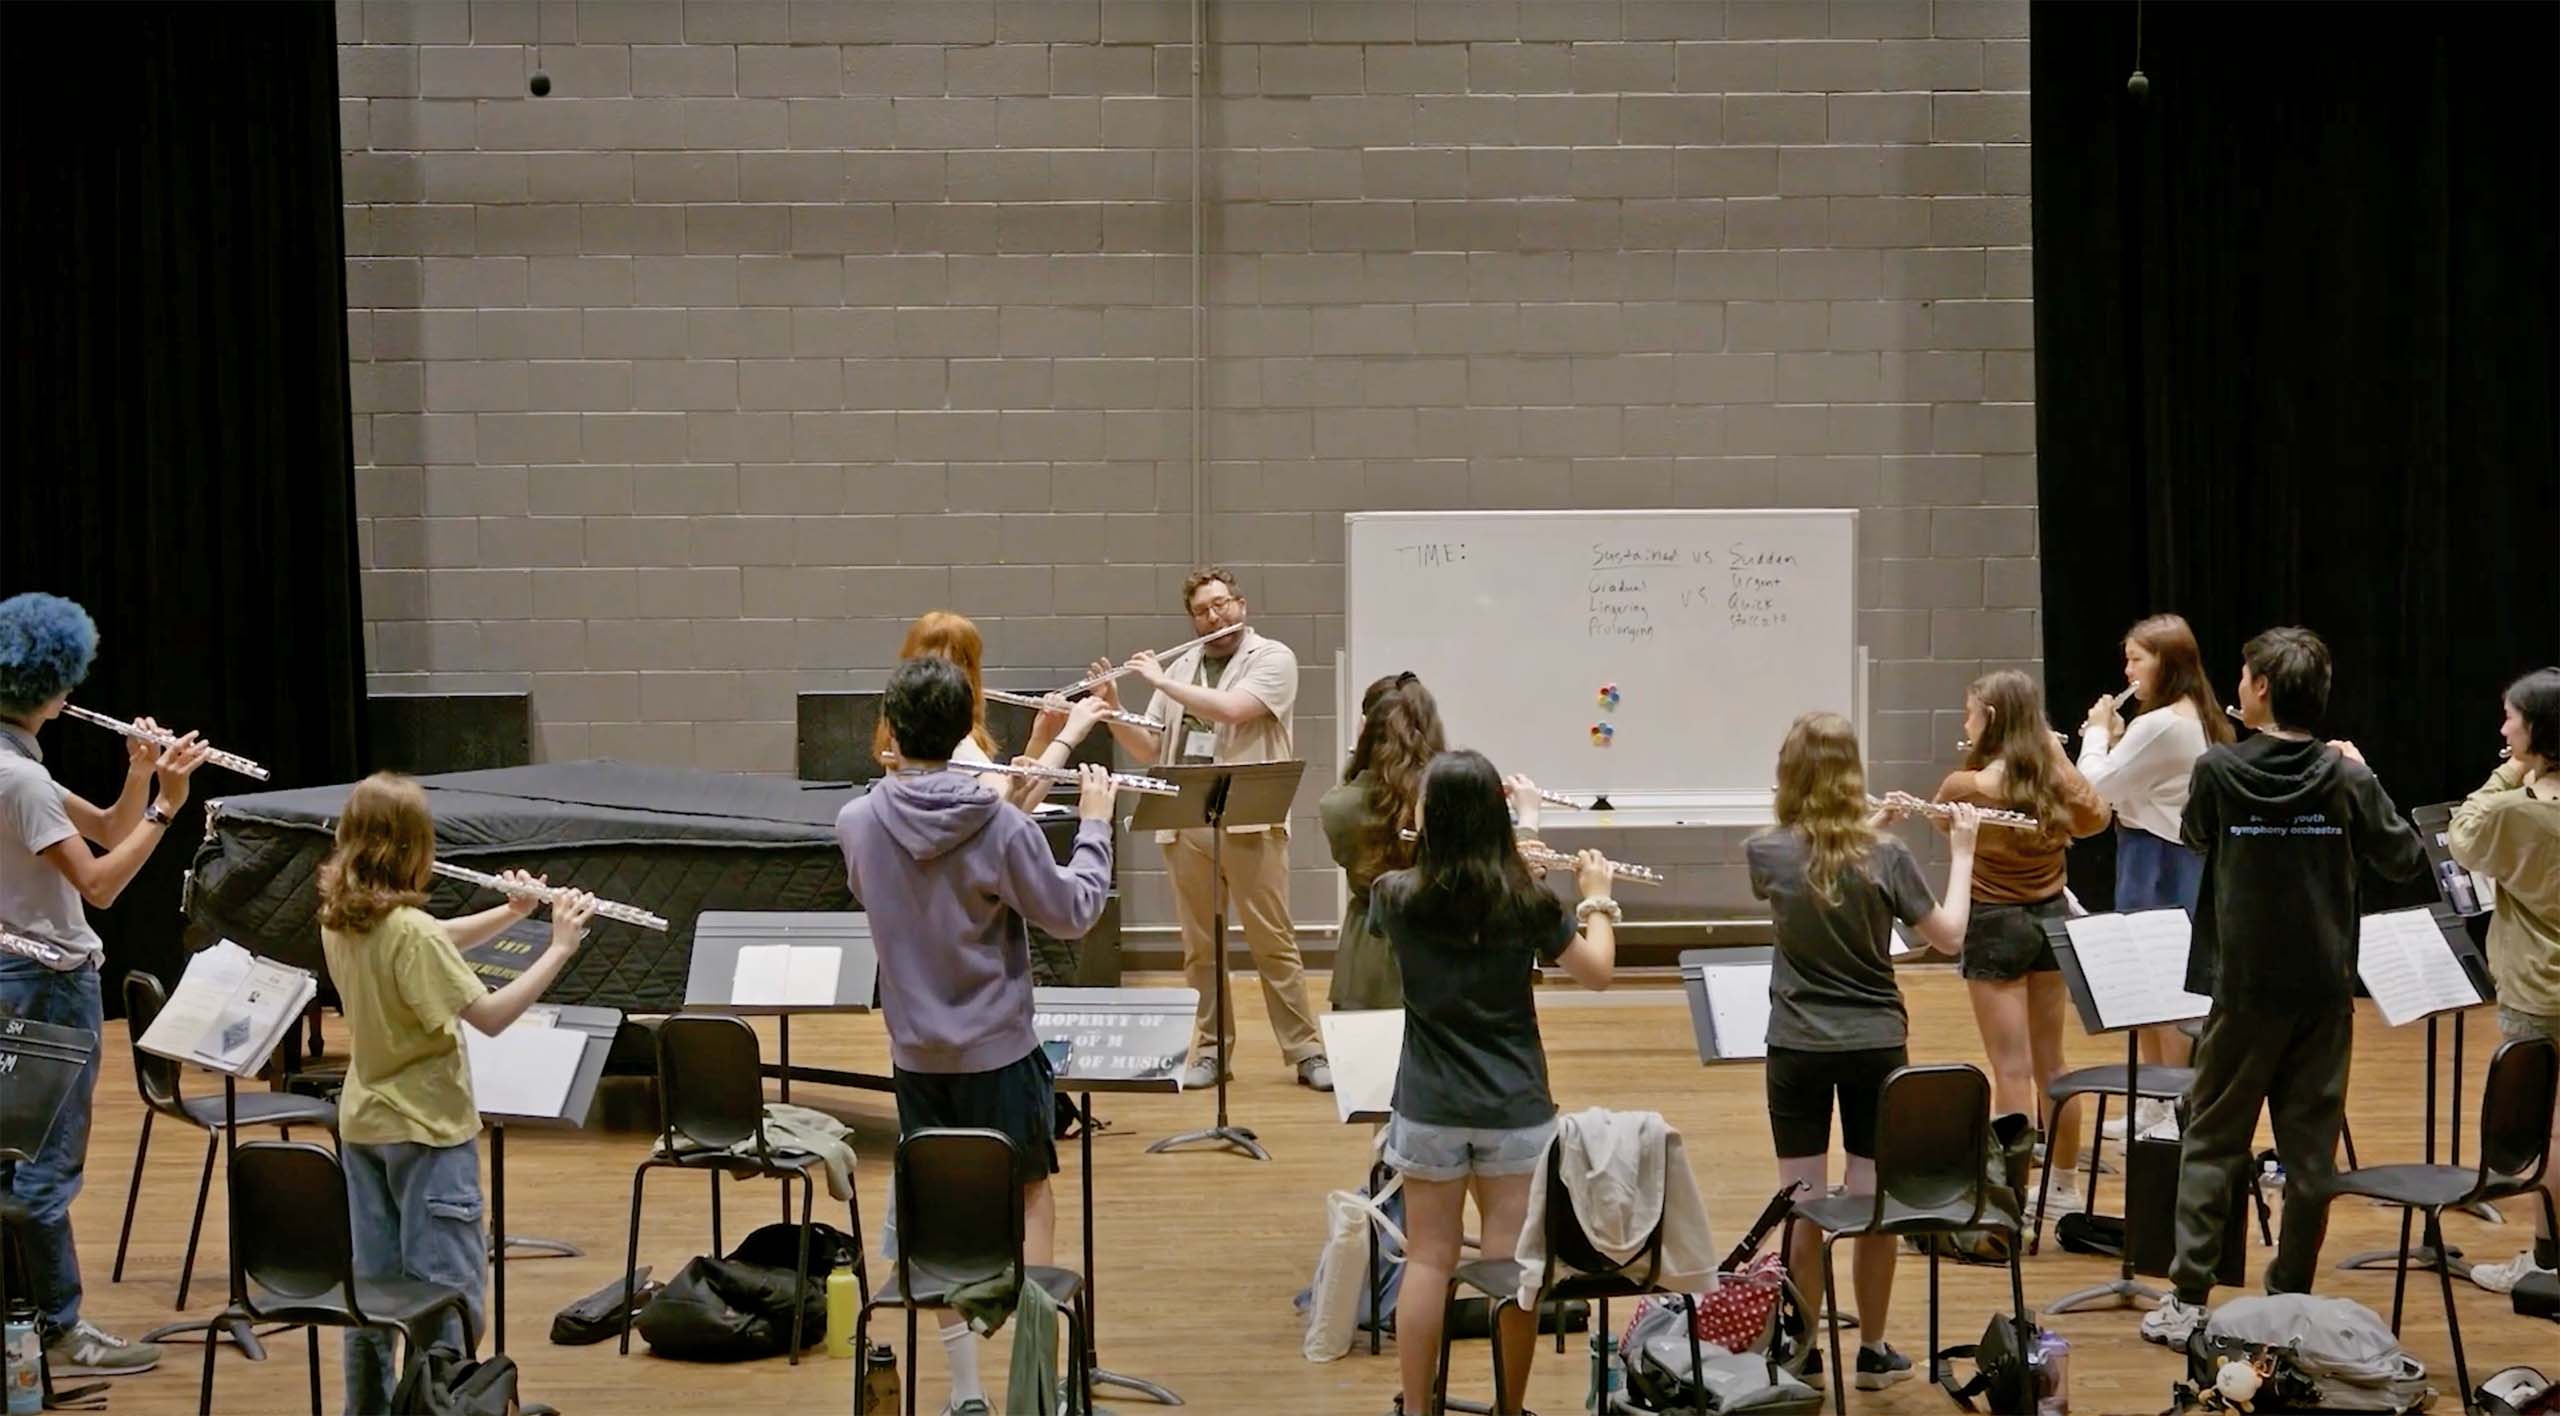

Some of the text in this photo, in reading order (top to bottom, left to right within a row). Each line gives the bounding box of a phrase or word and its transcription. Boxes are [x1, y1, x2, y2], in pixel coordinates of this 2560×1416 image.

[1393, 543, 1467, 568] TIME:
[1592, 544, 1679, 568] Sustained
[2293, 813, 2325, 824] youth
[2230, 825, 2343, 836] symphony orchestra
[1139, 1014, 1165, 1027] OF
[1075, 1034, 1102, 1048] OF
[1107, 1034, 1124, 1048] M
[1077, 1055, 1174, 1070] OF MUSIC
